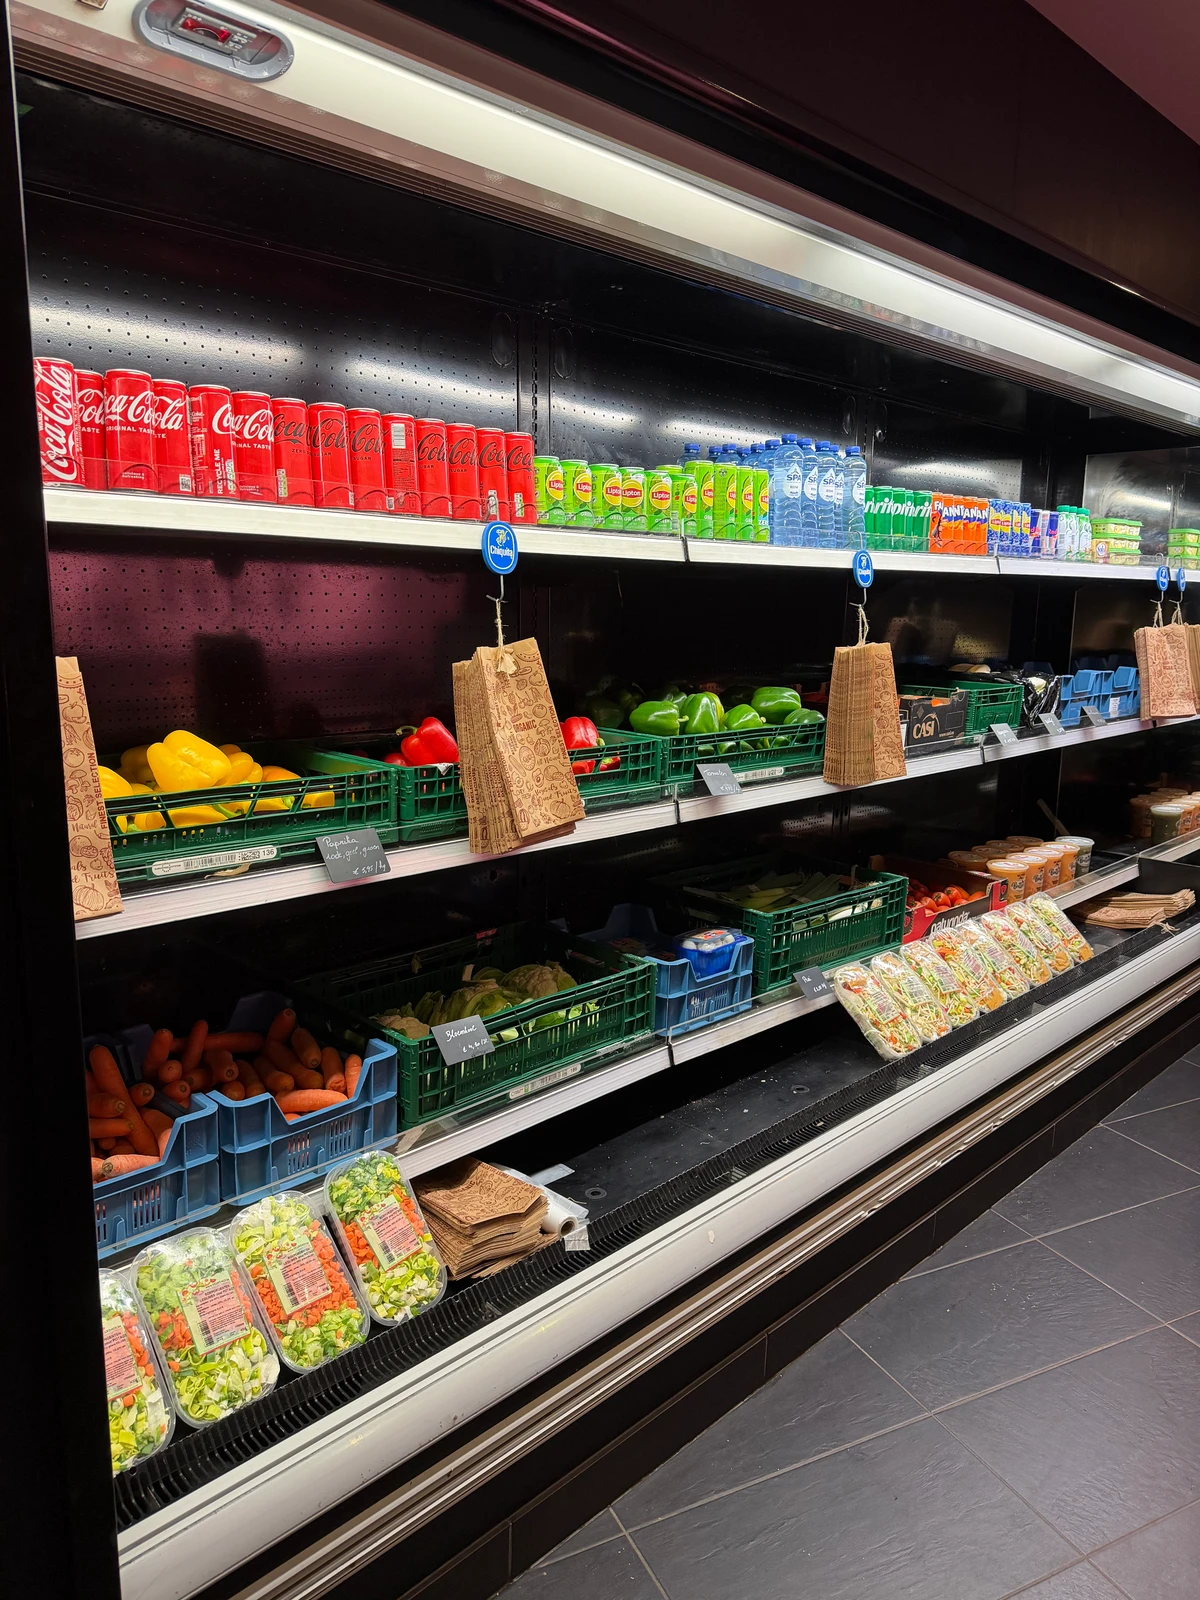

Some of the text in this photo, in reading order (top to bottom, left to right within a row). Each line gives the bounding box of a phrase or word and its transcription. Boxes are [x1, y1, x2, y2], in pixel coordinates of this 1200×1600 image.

[213, 449, 224, 494] RECYCLE ME
[622, 489, 641, 497] Lipton
[490, 544, 514, 559] Chiquita
[512, 719, 538, 734] ORGANIC
[547, 704, 562, 739] SELECTION
[912, 720, 936, 739] CASI
[87, 752, 108, 830] FINEST SELECTION
[322, 835, 360, 850] Paprika
[262, 849, 275, 857] 136
